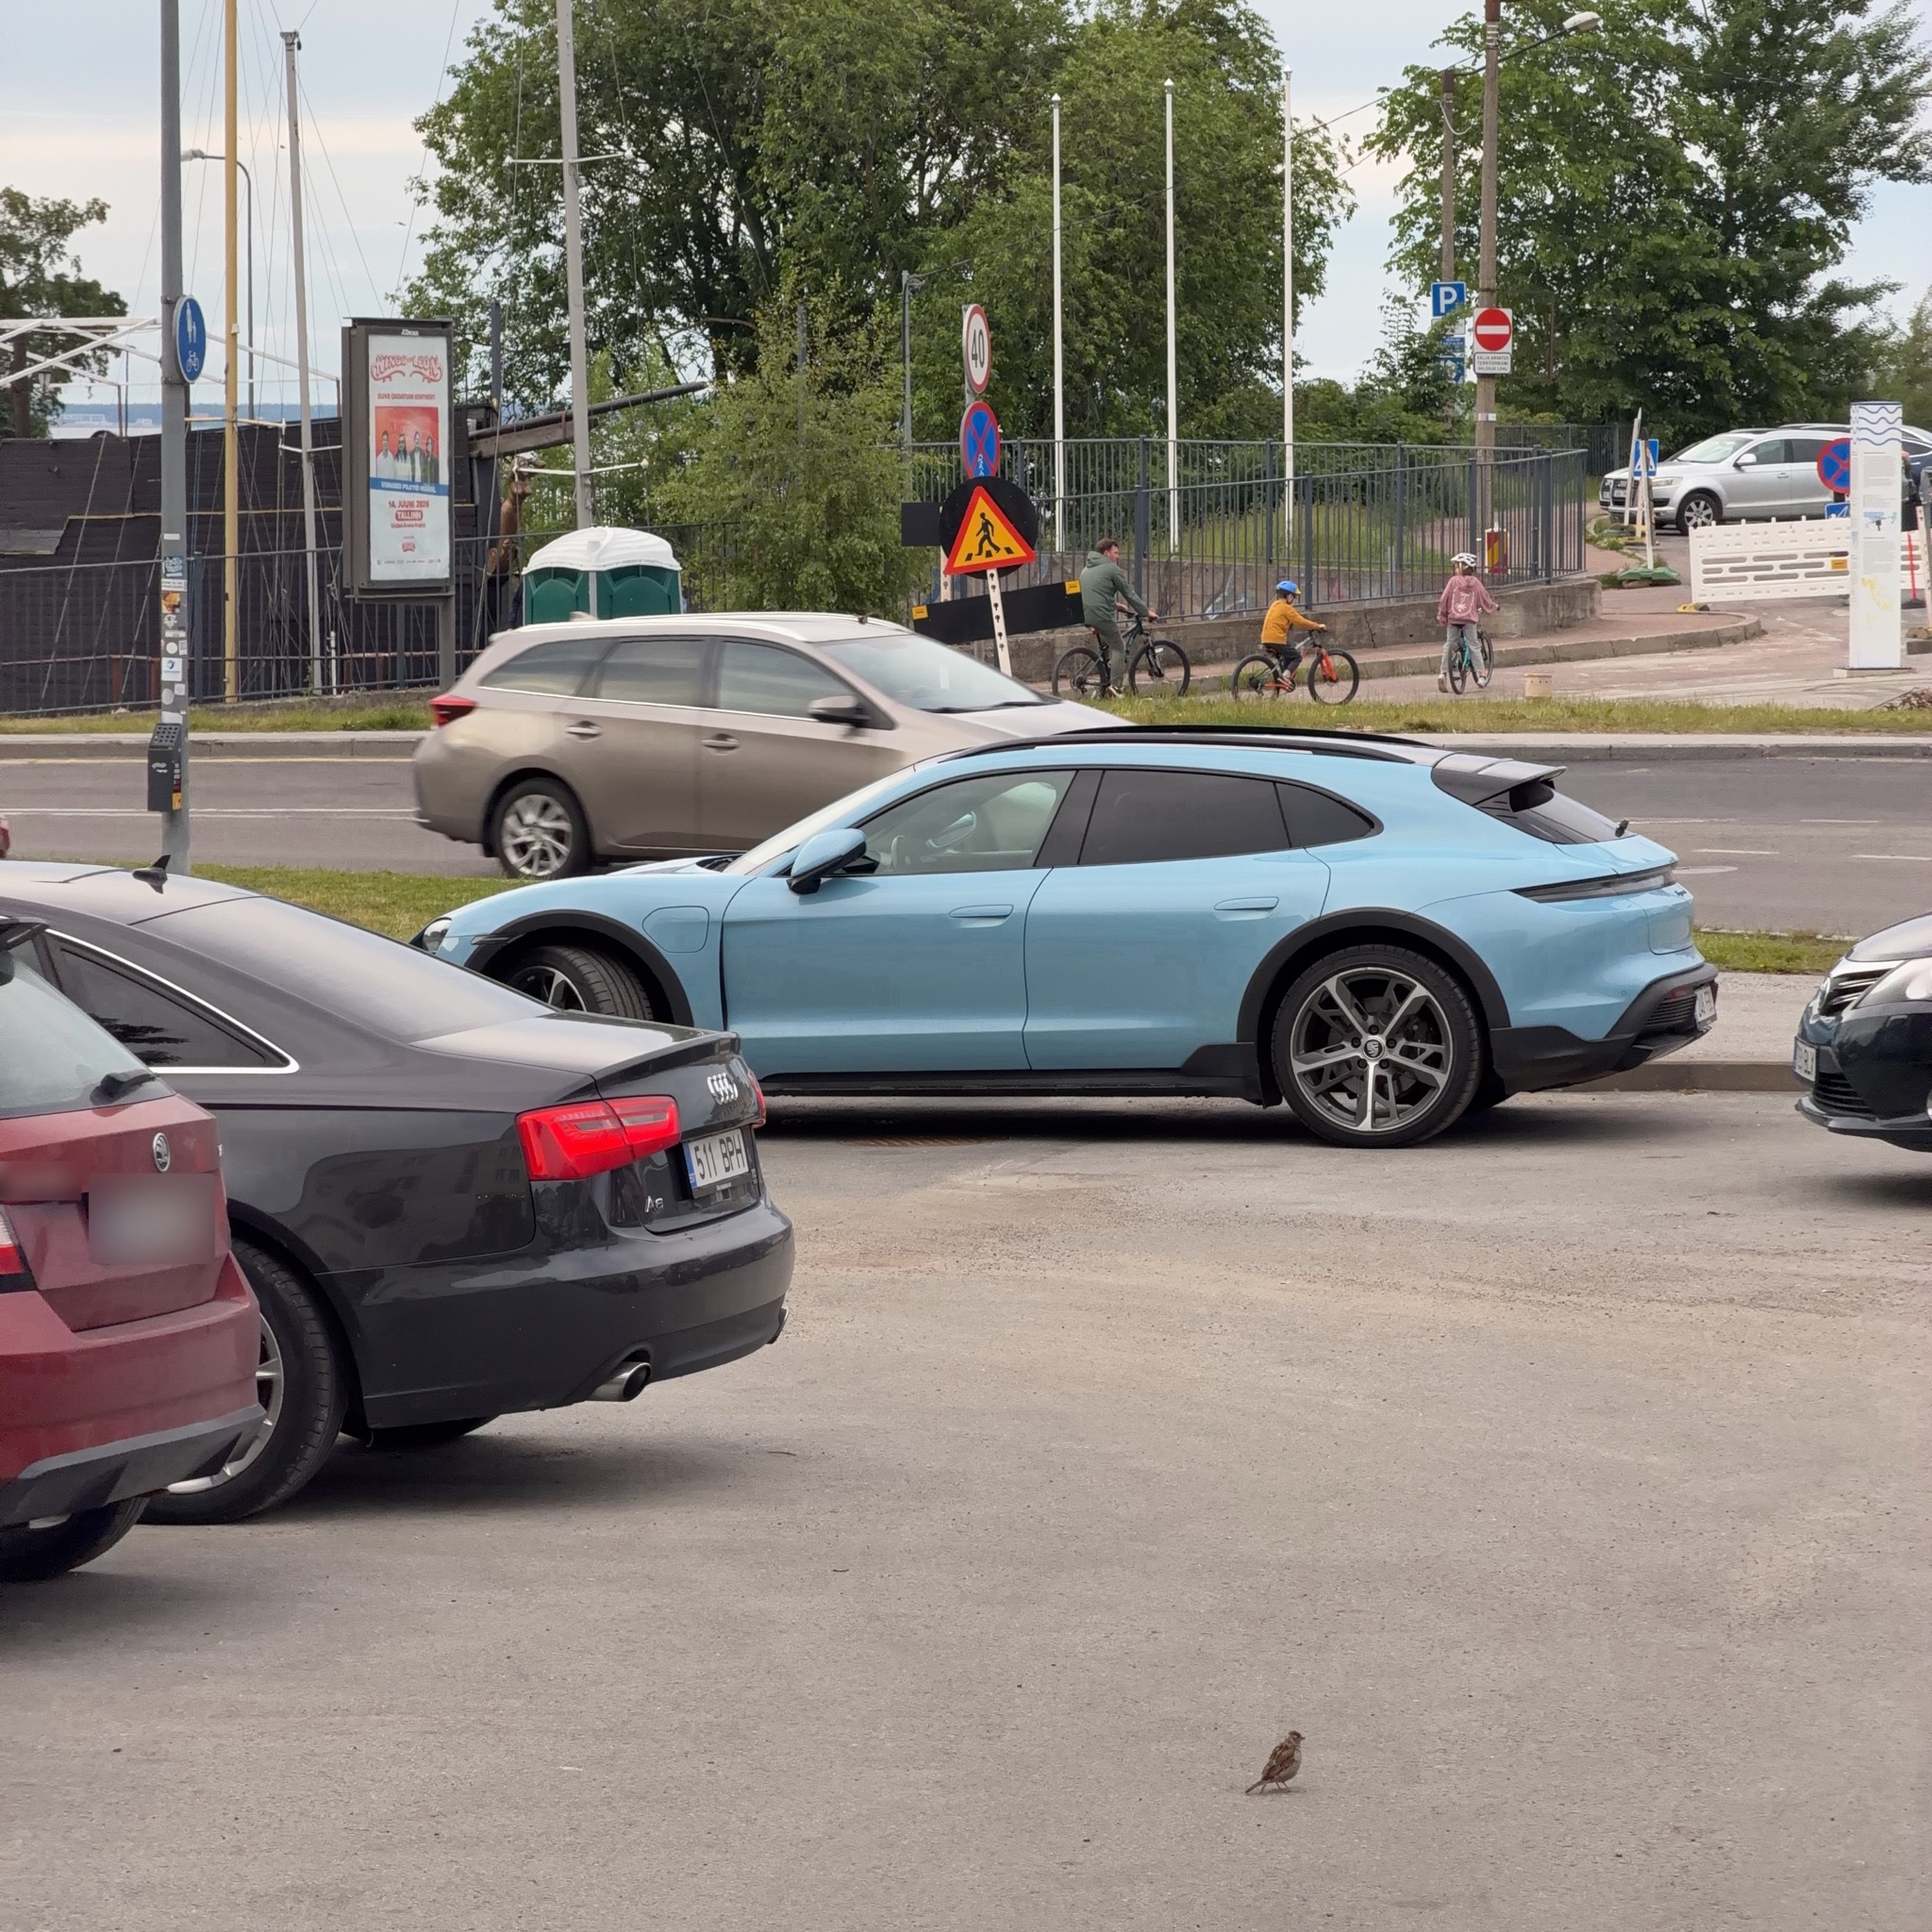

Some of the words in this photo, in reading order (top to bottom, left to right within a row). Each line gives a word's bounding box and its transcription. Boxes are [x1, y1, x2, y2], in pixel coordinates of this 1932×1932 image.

[1439, 286, 1457, 313] P
[971, 329, 985, 369] 40
[388, 500, 396, 508] 14.
[397, 500, 415, 508] JUUNI
[416, 500, 430, 508] 2026
[396, 511, 422, 520] TALLINN
[693, 1141, 718, 1180] 511
[719, 1134, 746, 1173] BPH
[644, 1195, 664, 1213] A6
